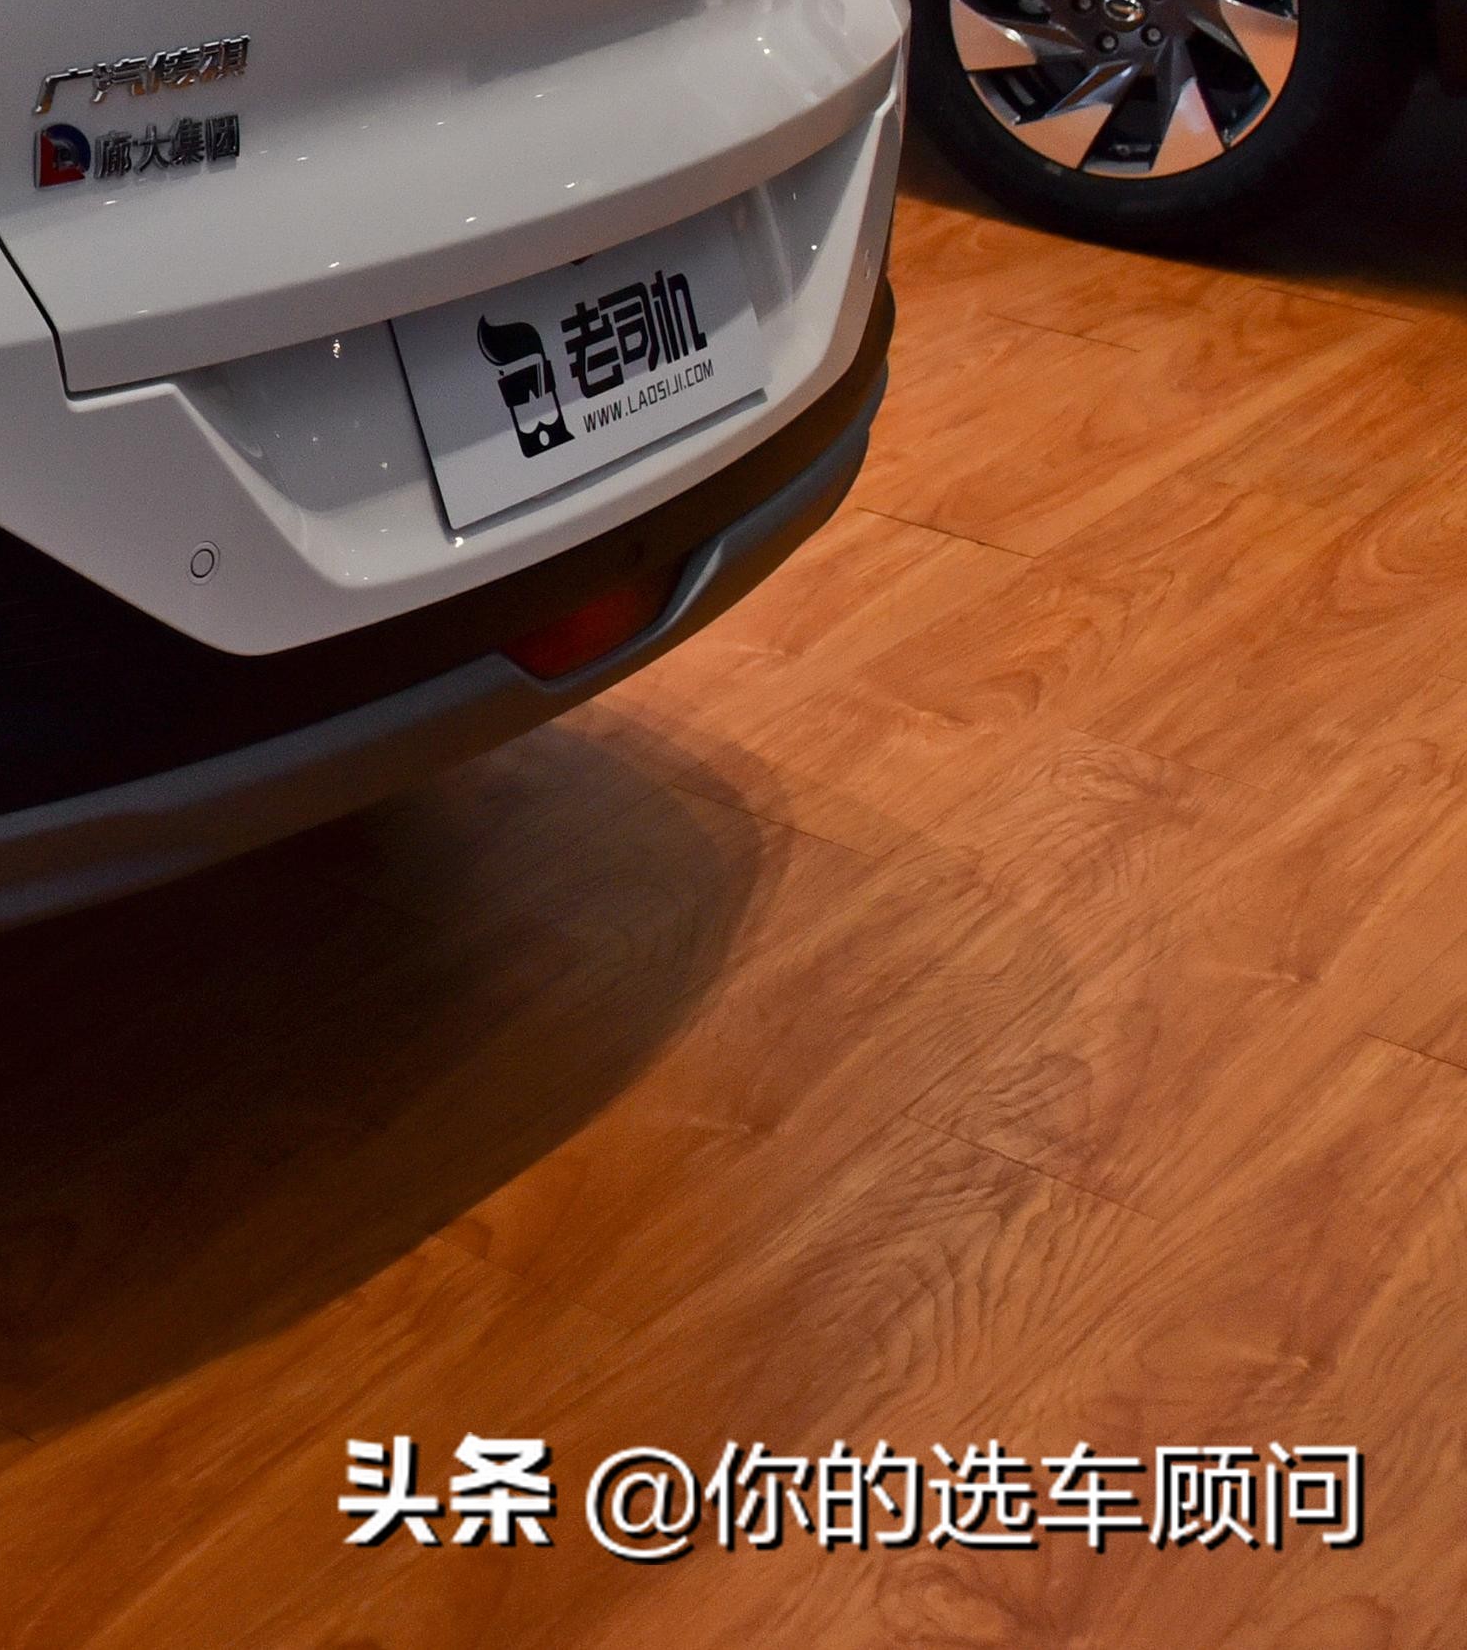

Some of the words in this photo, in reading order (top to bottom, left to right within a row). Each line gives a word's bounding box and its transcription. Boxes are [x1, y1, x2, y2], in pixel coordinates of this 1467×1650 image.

[34, 34, 250, 114] 广汽传祺
[561, 270, 708, 398] 老司机
[583, 359, 714, 433] WWW.LAOSIJI.COM
